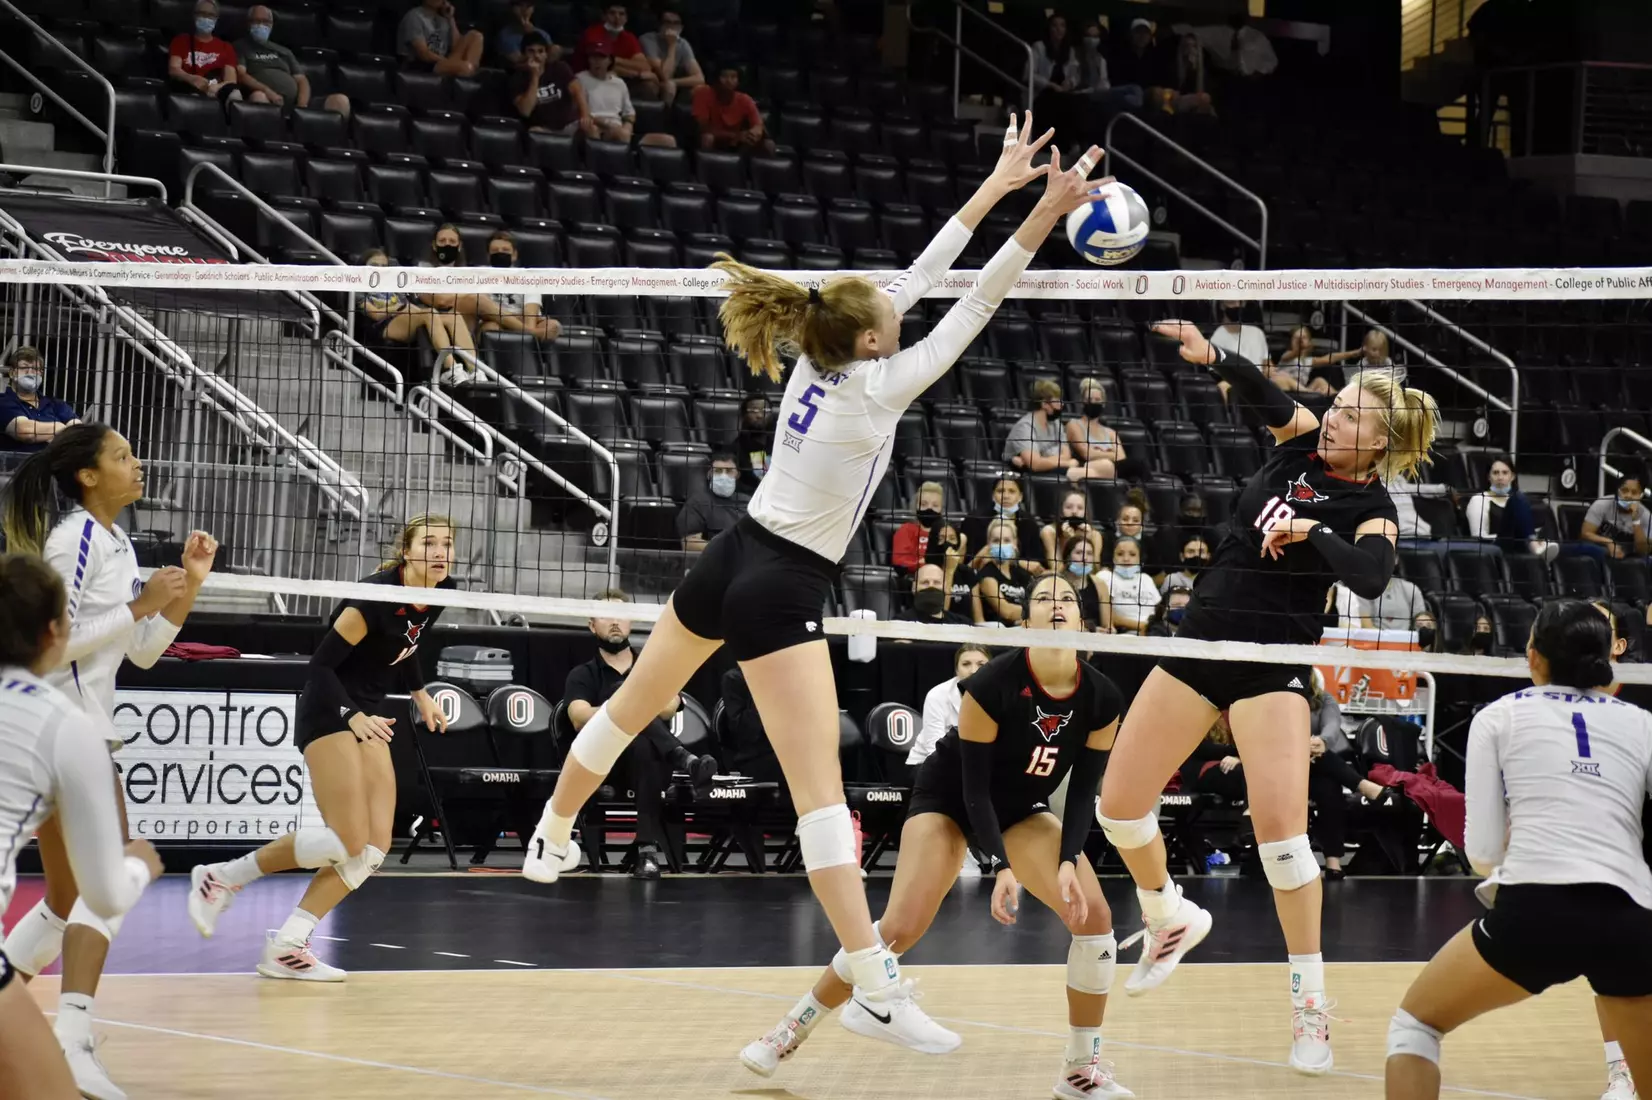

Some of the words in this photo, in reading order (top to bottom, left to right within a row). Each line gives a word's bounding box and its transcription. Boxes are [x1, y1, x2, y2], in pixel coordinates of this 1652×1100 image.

[44, 232, 188, 256] Everyone
[22, 266, 43, 276] College
[94, 268, 129, 281] Community
[130, 270, 150, 279] Service
[154, 270, 191, 281] Gerontology
[195, 271, 222, 280] Goodrich
[224, 271, 250, 280] Scholars
[254, 272, 272, 281] Public
[275, 273, 319, 282] Administration
[324, 274, 344, 282] Social
[345, 274, 362, 283] Work
[415, 275, 441, 284] Aviation
[446, 275, 474, 285] Criminal
[476, 276, 498, 285] Justice
[503, 276, 560, 288] Multidisciplinary
[560, 276, 585, 286] Studies
[590, 276, 629, 288] Emergency
[632, 277, 677, 288] Management
[682, 277, 709, 289] College
[711, 278, 720, 286] of
[944, 278, 974, 288] Scholar
[1014, 278, 1068, 289] dministration
[1076, 280, 1100, 289] Social
[1103, 280, 1124, 289] Work
[1195, 279, 1231, 289] Aviation
[1237, 279, 1274, 289] Criminal
[1277, 279, 1307, 289] Justice
[1314, 278, 1388, 291] Multidisciplinary
[1390, 278, 1424, 289] Studies
[1432, 278, 1482, 292] Emergency
[1485, 278, 1548, 292] Management
[1555, 278, 1592, 291] College
[1596, 277, 1604, 288] of
[1607, 277, 1636, 288] Public
[788, 384, 825, 434] 5
[1572, 712, 1591, 758] 1
[1025, 746, 1059, 777] 15
[482, 772, 520, 782] OMAHA
[710, 788, 746, 799] OMAHA
[867, 791, 902, 802] OMAHA
[137, 815, 298, 840] corporated
